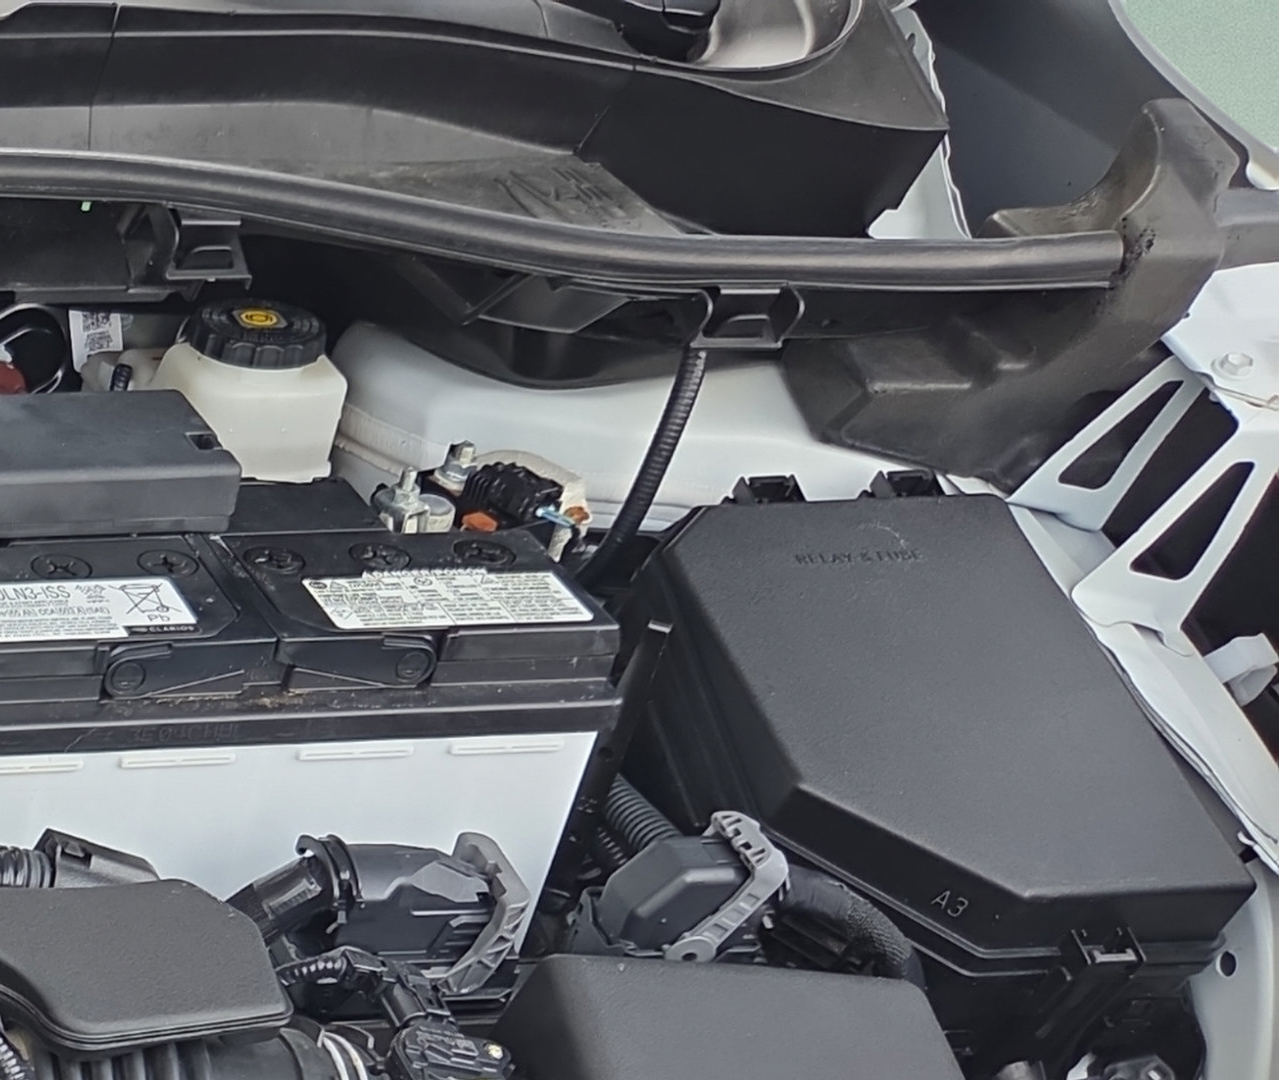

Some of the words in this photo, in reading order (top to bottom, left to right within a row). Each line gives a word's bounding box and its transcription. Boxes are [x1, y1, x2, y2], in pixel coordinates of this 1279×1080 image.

[794, 552, 852, 565] RELAY
[147, 614, 171, 623] Pb
[930, 890, 969, 917] A3
